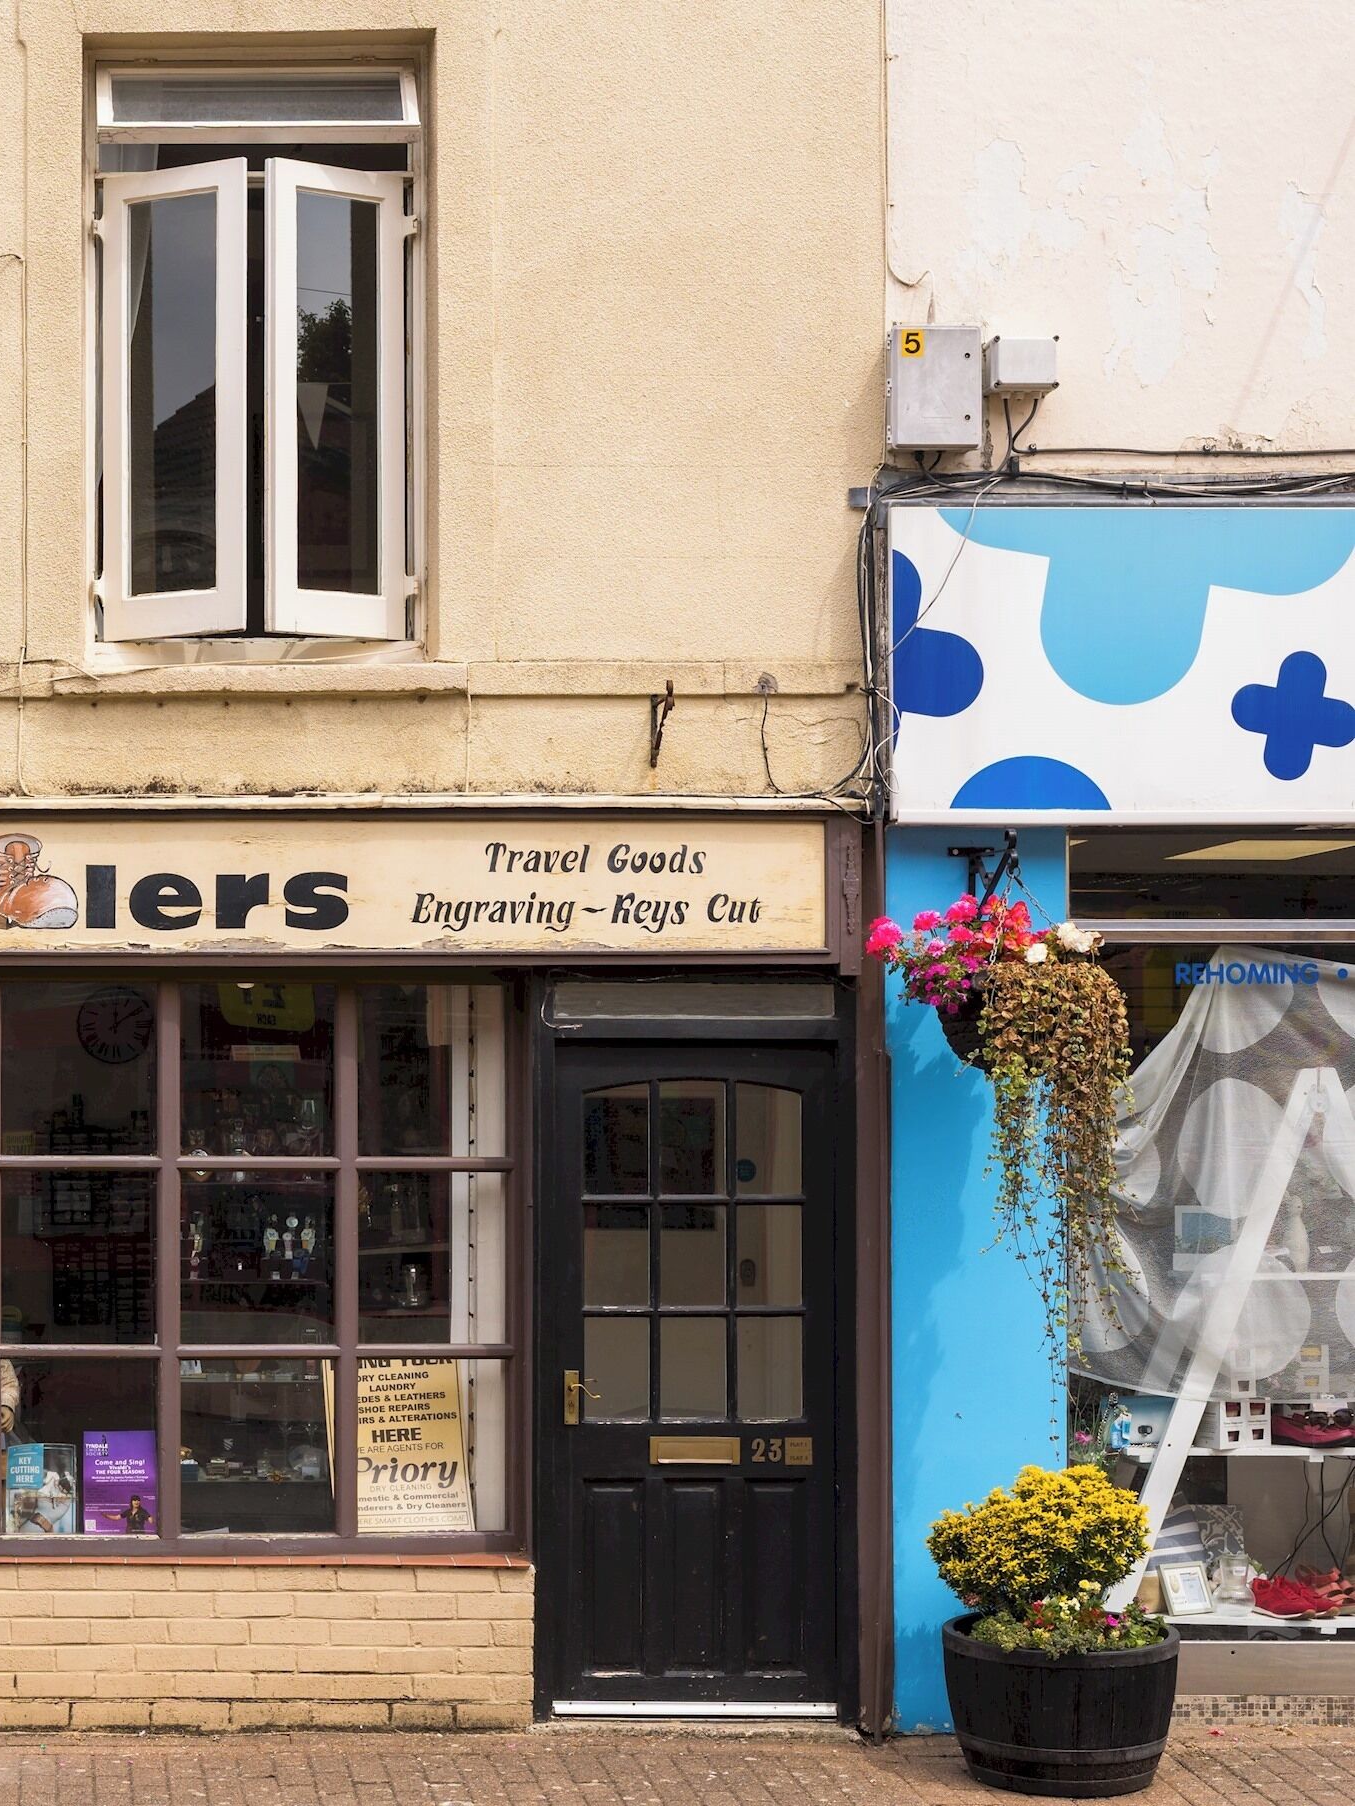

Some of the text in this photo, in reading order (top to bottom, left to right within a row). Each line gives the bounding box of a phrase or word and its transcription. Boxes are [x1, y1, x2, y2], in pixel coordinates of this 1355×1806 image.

[904, 332, 921, 354] 5
[485, 842, 707, 875] Travel Goods
[411, 891, 577, 933] Engraving
[610, 892, 691, 934] Keys
[706, 893, 762, 925] Cut
[1174, 960, 1320, 985] REHOMING
[378, 1371, 429, 1381] CLEANING
[369, 1382, 416, 1393] LAUNDRY
[384, 1394, 391, 1402] &
[394, 1391, 446, 1402] LEATHERS
[358, 1403, 431, 1414] SHOE REPAIRS
[378, 1415, 386, 1424] &
[389, 1411, 458, 1423] ALTERATIONS
[371, 1427, 422, 1443] HERE
[367, 1445, 387, 1454] ARE
[386, 1443, 423, 1453] AGENTS
[425, 1442, 445, 1450] FOR
[751, 1438, 783, 1463] 23
[18, 1456, 32, 1465] KEY
[128, 1459, 145, 1467] Sing!
[10, 1465, 40, 1474] CUTTING
[358, 1456, 458, 1489] Priory
[16, 1474, 34, 1483] HERE
[369, 1483, 432, 1493] DRY CLEANING
[403, 1491, 459, 1501] Commercial
[406, 1503, 422, 1511] Dry
[373, 1516, 402, 1525] SMART
[403, 1515, 440, 1524] CLOTHES
[441, 1515, 466, 1523] COME
